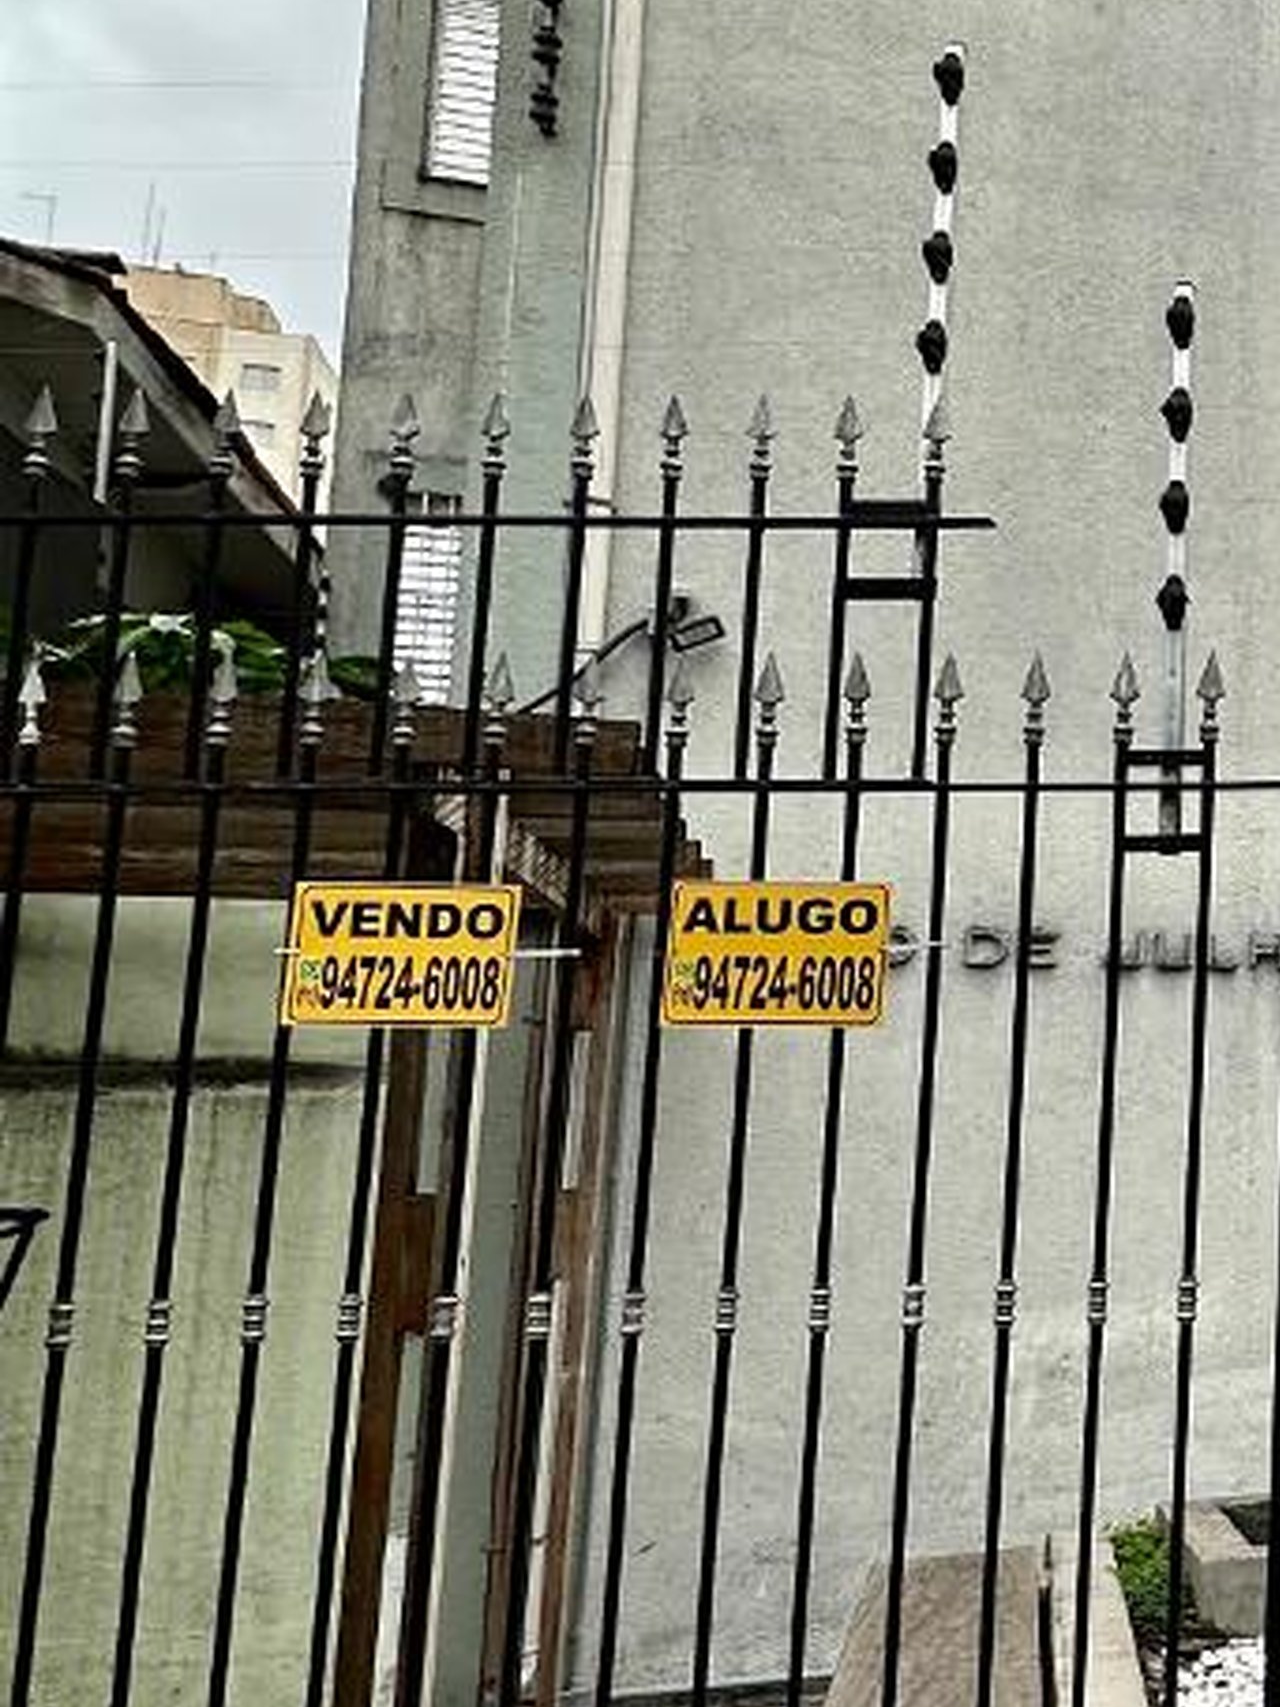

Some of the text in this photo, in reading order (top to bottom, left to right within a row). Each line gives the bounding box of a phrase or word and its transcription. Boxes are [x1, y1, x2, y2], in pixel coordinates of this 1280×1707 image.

[312, 901, 504, 939] VENDO
[682, 898, 878, 935] ALUGO
[320, 955, 500, 1010] 94724-6008
[693, 954, 876, 1010] 94724-6008
